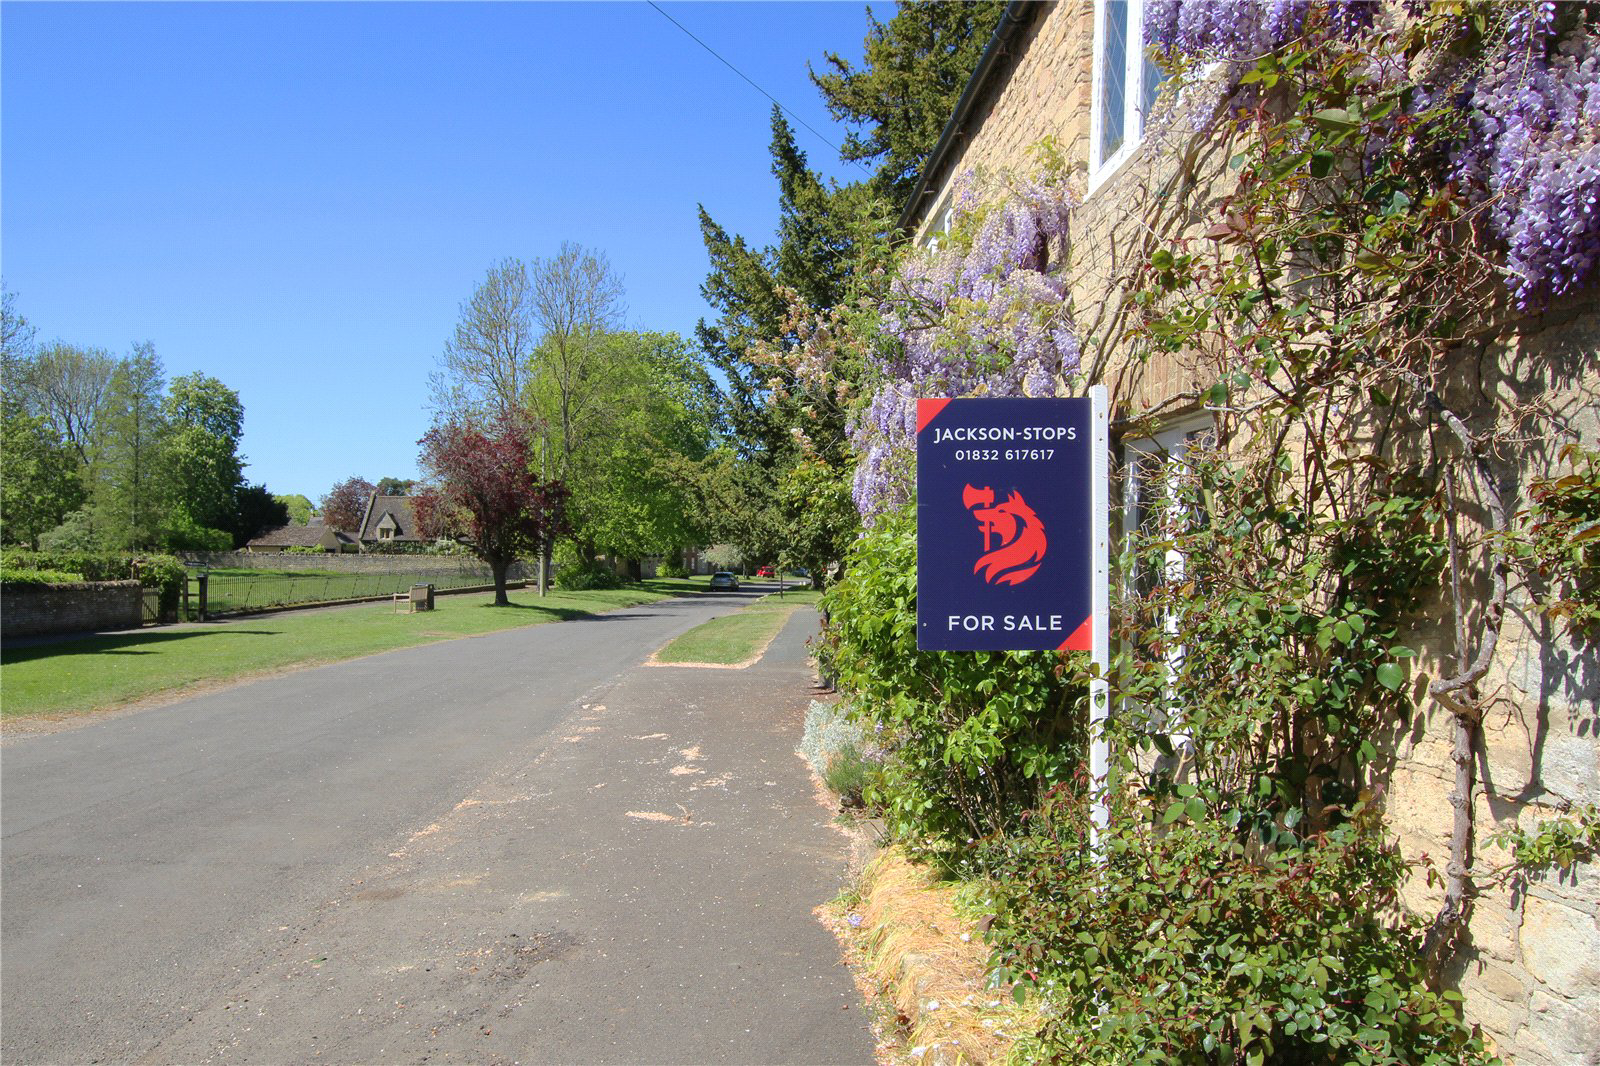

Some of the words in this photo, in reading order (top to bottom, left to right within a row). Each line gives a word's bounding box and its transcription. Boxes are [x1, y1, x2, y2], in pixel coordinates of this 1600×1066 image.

[934, 427, 1077, 443] JACKSON-STOPS
[955, 449, 999, 461] 01832
[1005, 449, 1055, 461] 617617
[948, 615, 994, 631] FOR
[1003, 615, 1062, 631] SALE
